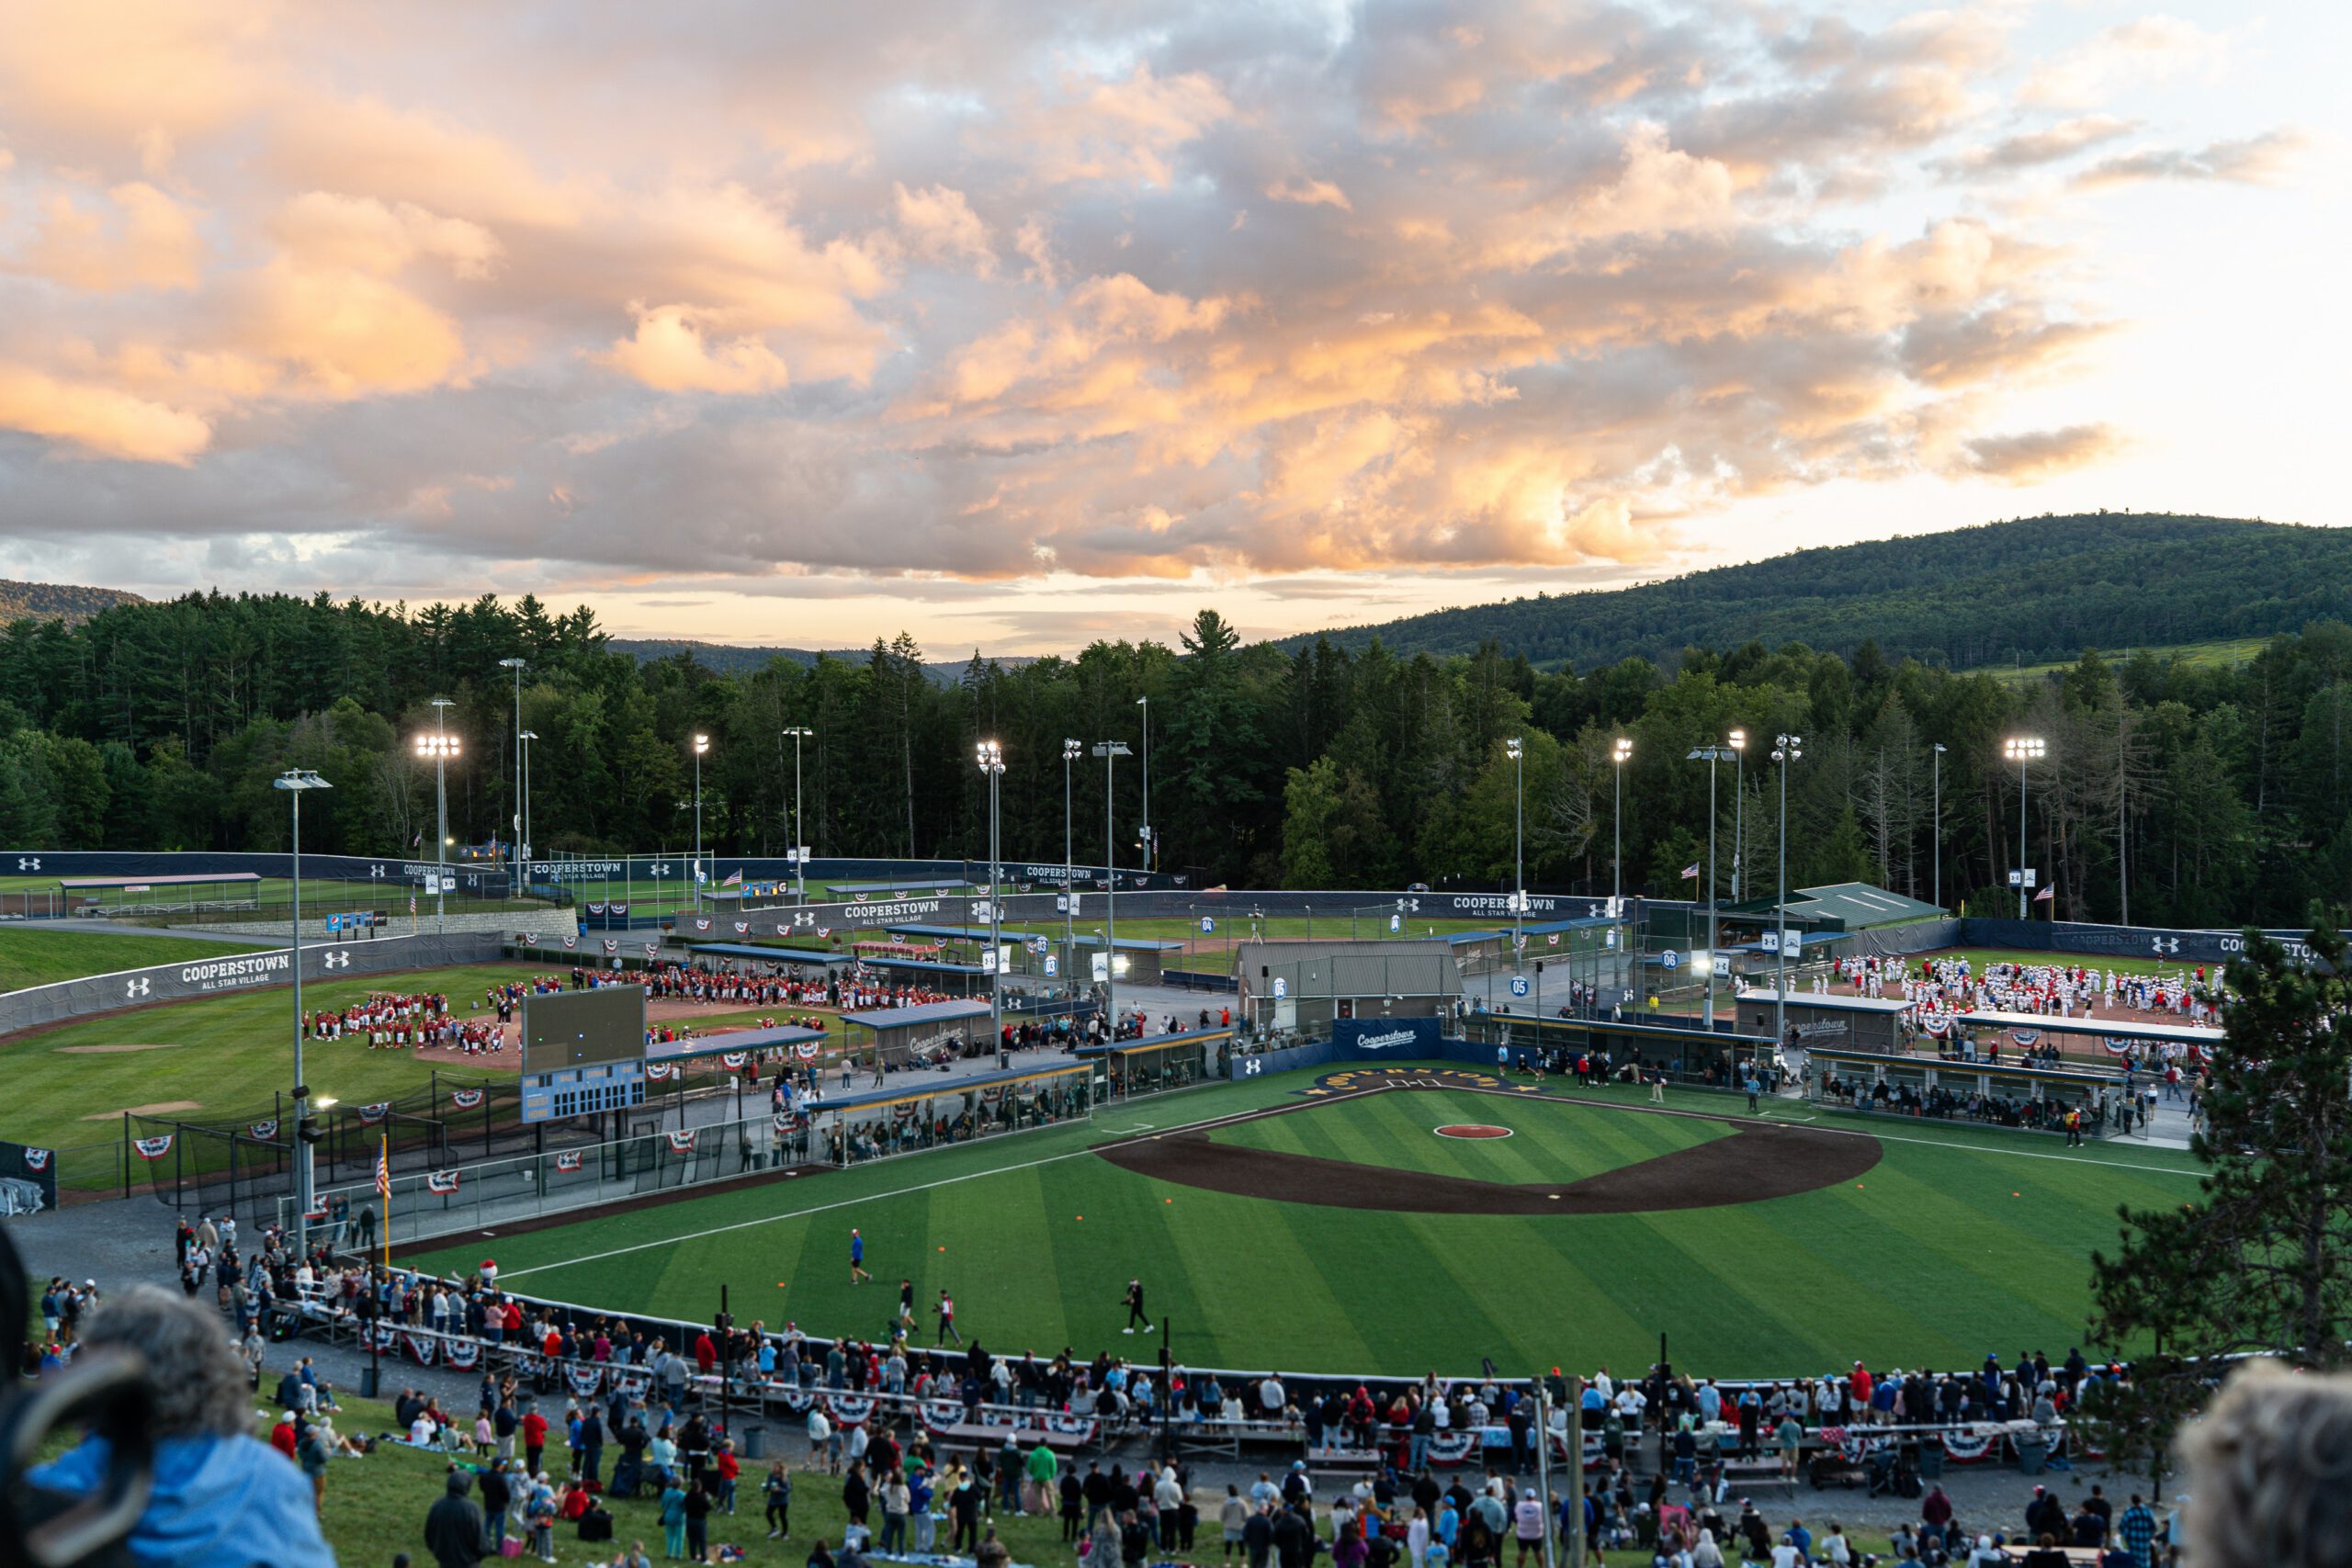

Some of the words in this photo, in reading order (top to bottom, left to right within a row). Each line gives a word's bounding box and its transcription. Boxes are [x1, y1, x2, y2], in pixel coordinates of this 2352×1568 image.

[535, 863, 621, 874] COOPERSTOWN
[1026, 866, 1091, 879] COOPERSOWN
[778, 882, 787, 893] G
[845, 901, 939, 919] COOPERSTOWN
[895, 914, 922, 923] VILLAGE
[1202, 920, 1212, 931] 04
[1037, 941, 1046, 952] 03
[1664, 954, 1676, 965] 06
[183, 955, 288, 982] COOPERSTOWN
[1046, 960, 1056, 973] 03
[202, 981, 216, 989] ALL
[218, 978, 237, 987] STAR
[239, 974, 269, 985] VILLAGE
[1513, 981, 1525, 993] 05
[1274, 983, 1284, 996] 05
[1357, 1030, 1416, 1047] Cooperstown
